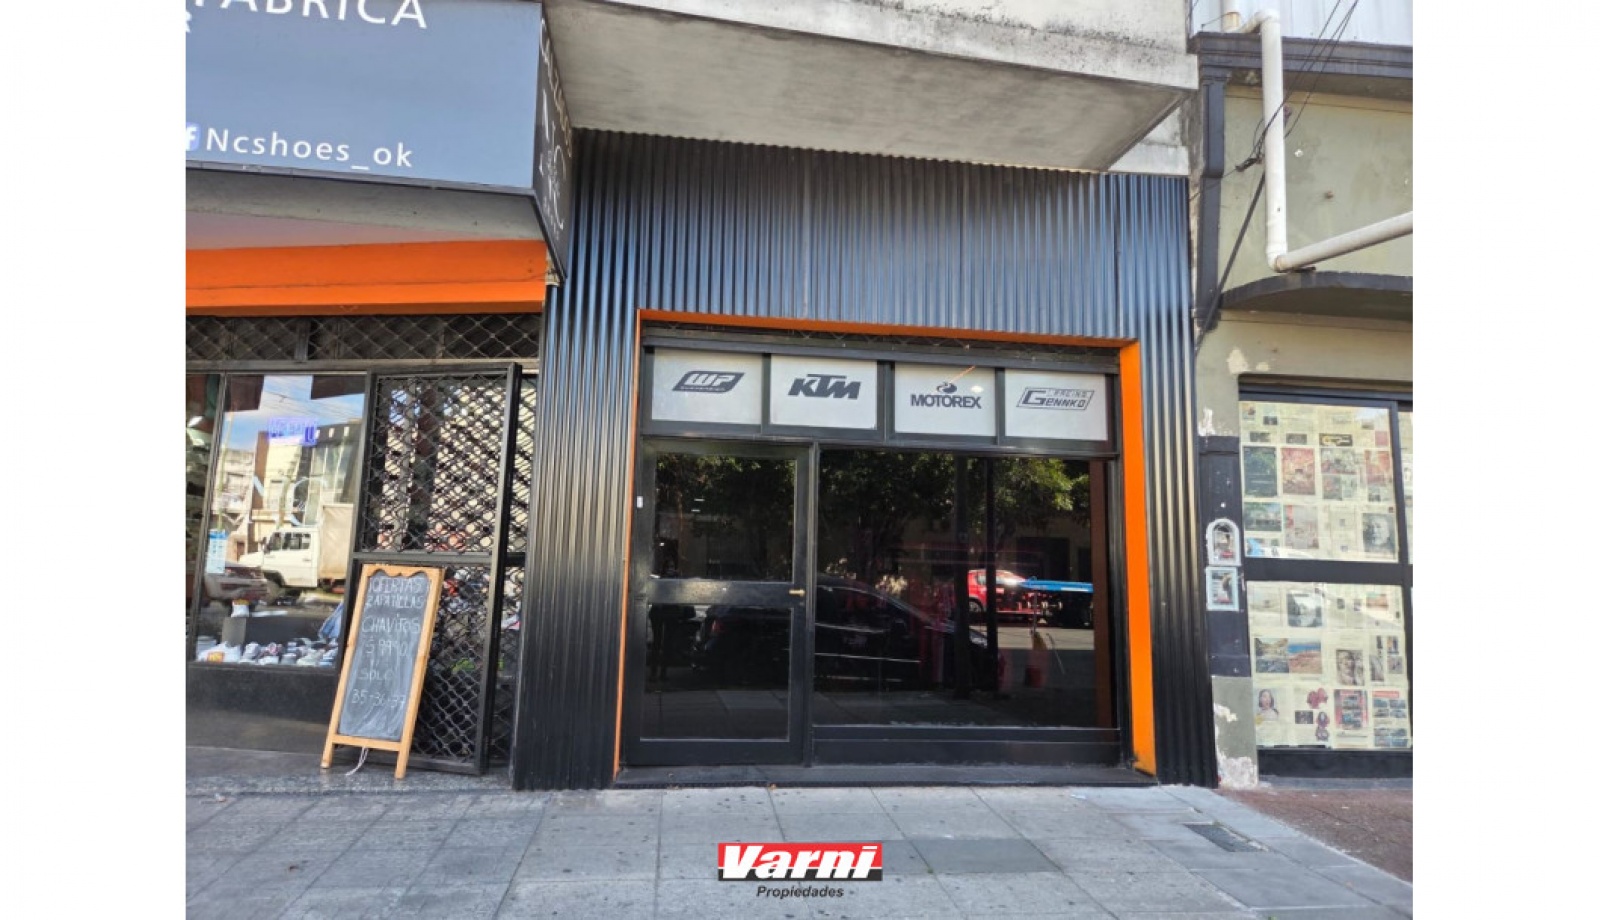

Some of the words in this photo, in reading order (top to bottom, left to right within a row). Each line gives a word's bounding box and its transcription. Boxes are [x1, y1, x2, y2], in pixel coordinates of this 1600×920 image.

[206, 127, 412, 168] Ncshoes_ok
[788, 374, 861, 400] KTM
[910, 393, 982, 409] MOTOREX
